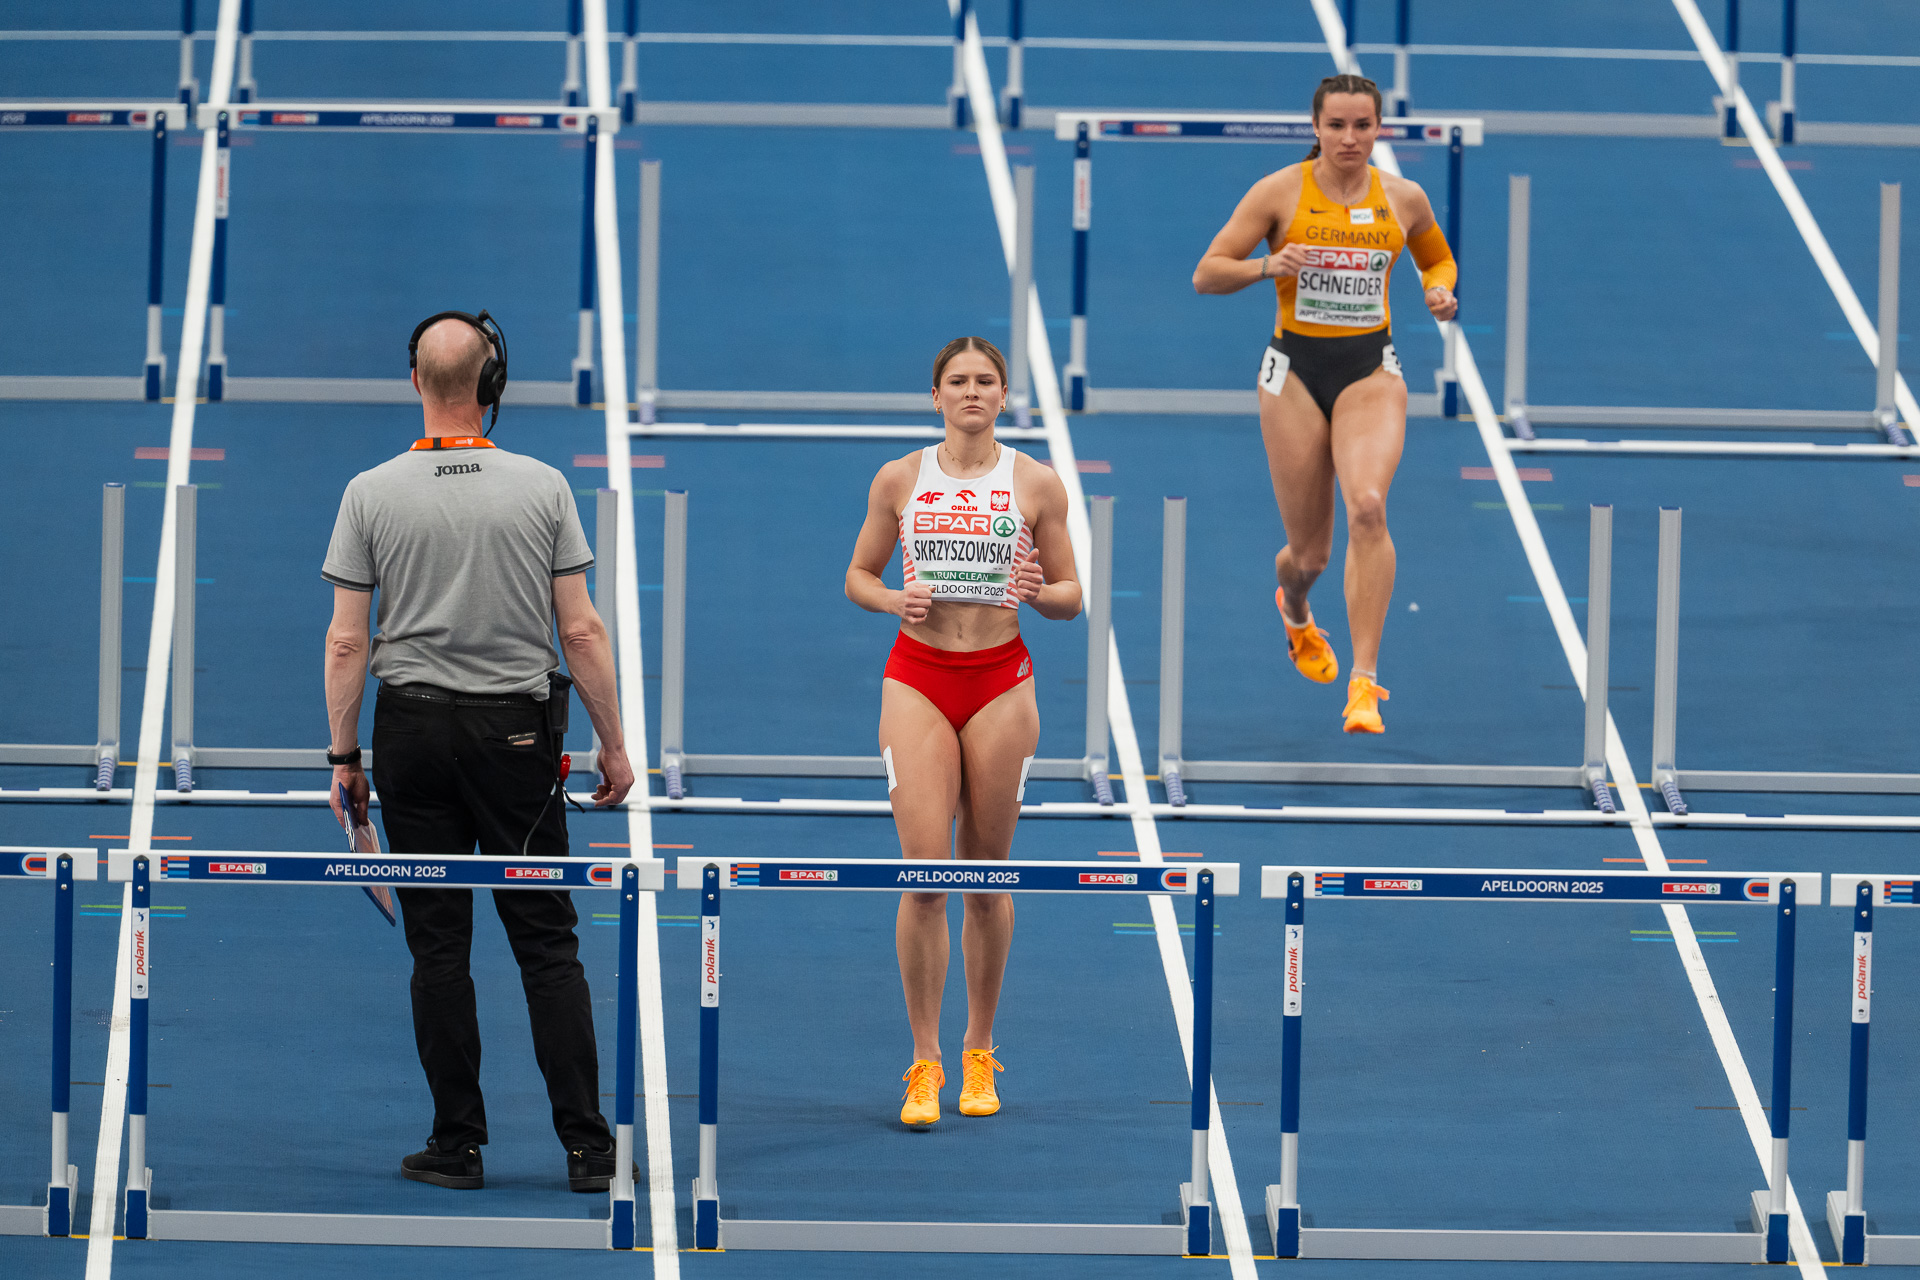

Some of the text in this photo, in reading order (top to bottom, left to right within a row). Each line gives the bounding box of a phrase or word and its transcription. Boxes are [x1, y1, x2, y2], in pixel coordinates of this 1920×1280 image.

[1305, 225, 1390, 245] GERMANY
[1306, 251, 1368, 268] SPAR
[1299, 271, 1382, 295] SCHNEIDER
[1266, 357, 1275, 383] 3
[916, 514, 989, 533] SPAR
[914, 539, 1012, 565] SKRZYSZOWSKA
[938, 572, 957, 580] RUN
[958, 572, 989, 581] CLEAN
[984, 586, 1005, 596] 2025
[219, 864, 252, 872] SPAR
[324, 864, 447, 878] APELDOORN 2025
[515, 869, 549, 877] SPAR
[790, 871, 824, 879] SPAR
[896, 870, 1020, 884] APELDOORN 2025
[1089, 875, 1123, 883] SPAR
[1481, 880, 1604, 894] APELDOORN 2025
[1672, 884, 1706, 892] SPAR
[134, 930, 146, 976] polanik
[705, 938, 716, 984] polanik
[1288, 947, 1300, 993] polanik
[1856, 954, 1868, 1000] polanik
